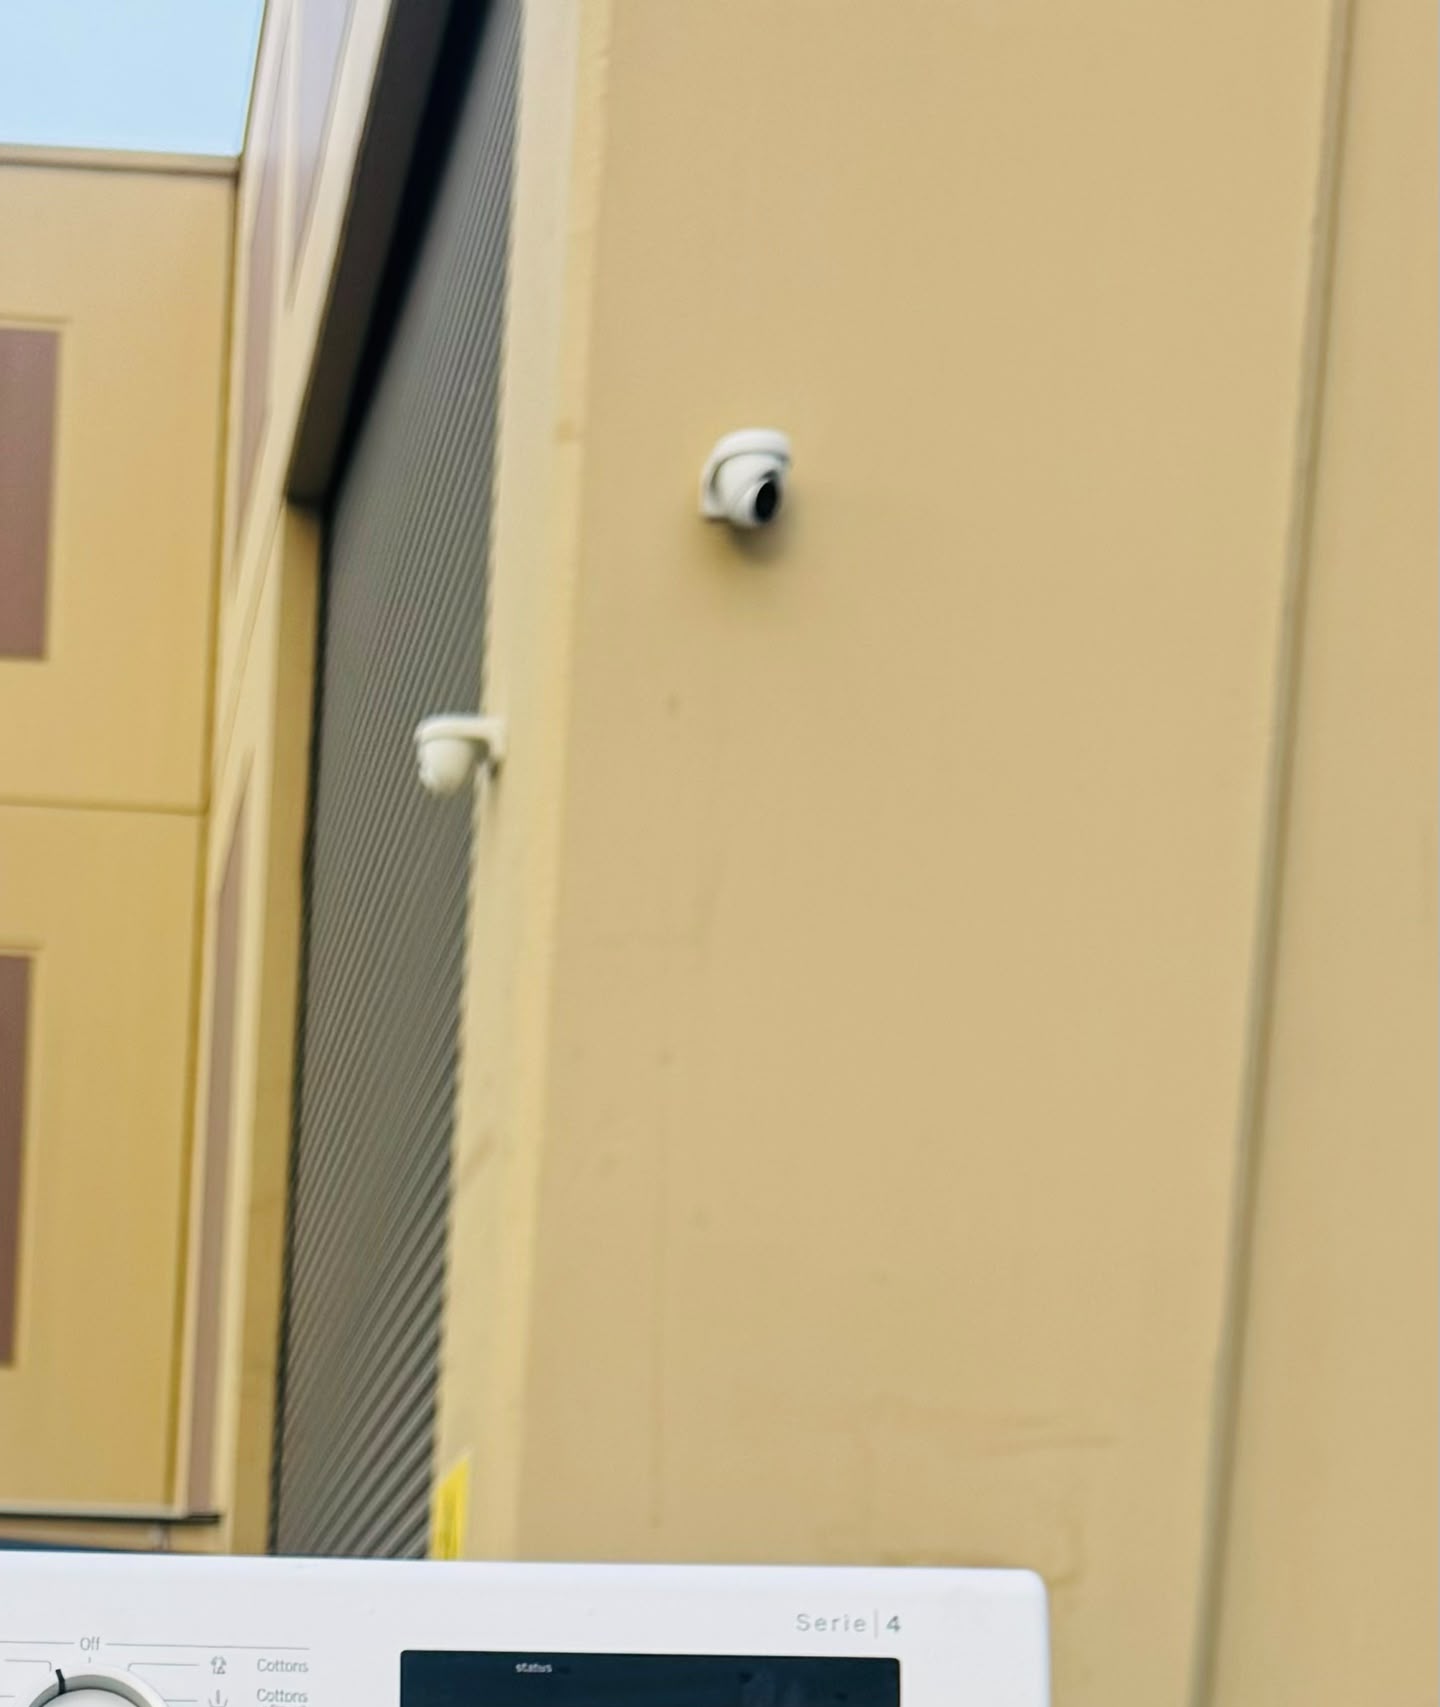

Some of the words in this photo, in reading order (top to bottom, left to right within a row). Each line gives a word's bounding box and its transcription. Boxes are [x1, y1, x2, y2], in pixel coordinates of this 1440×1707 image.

[796, 1613, 867, 1632] Serie
[886, 1615, 901, 1632] 4
[80, 1636, 101, 1651] Off
[257, 1658, 309, 1673] Cottons
[256, 1688, 309, 1703] Cottons
